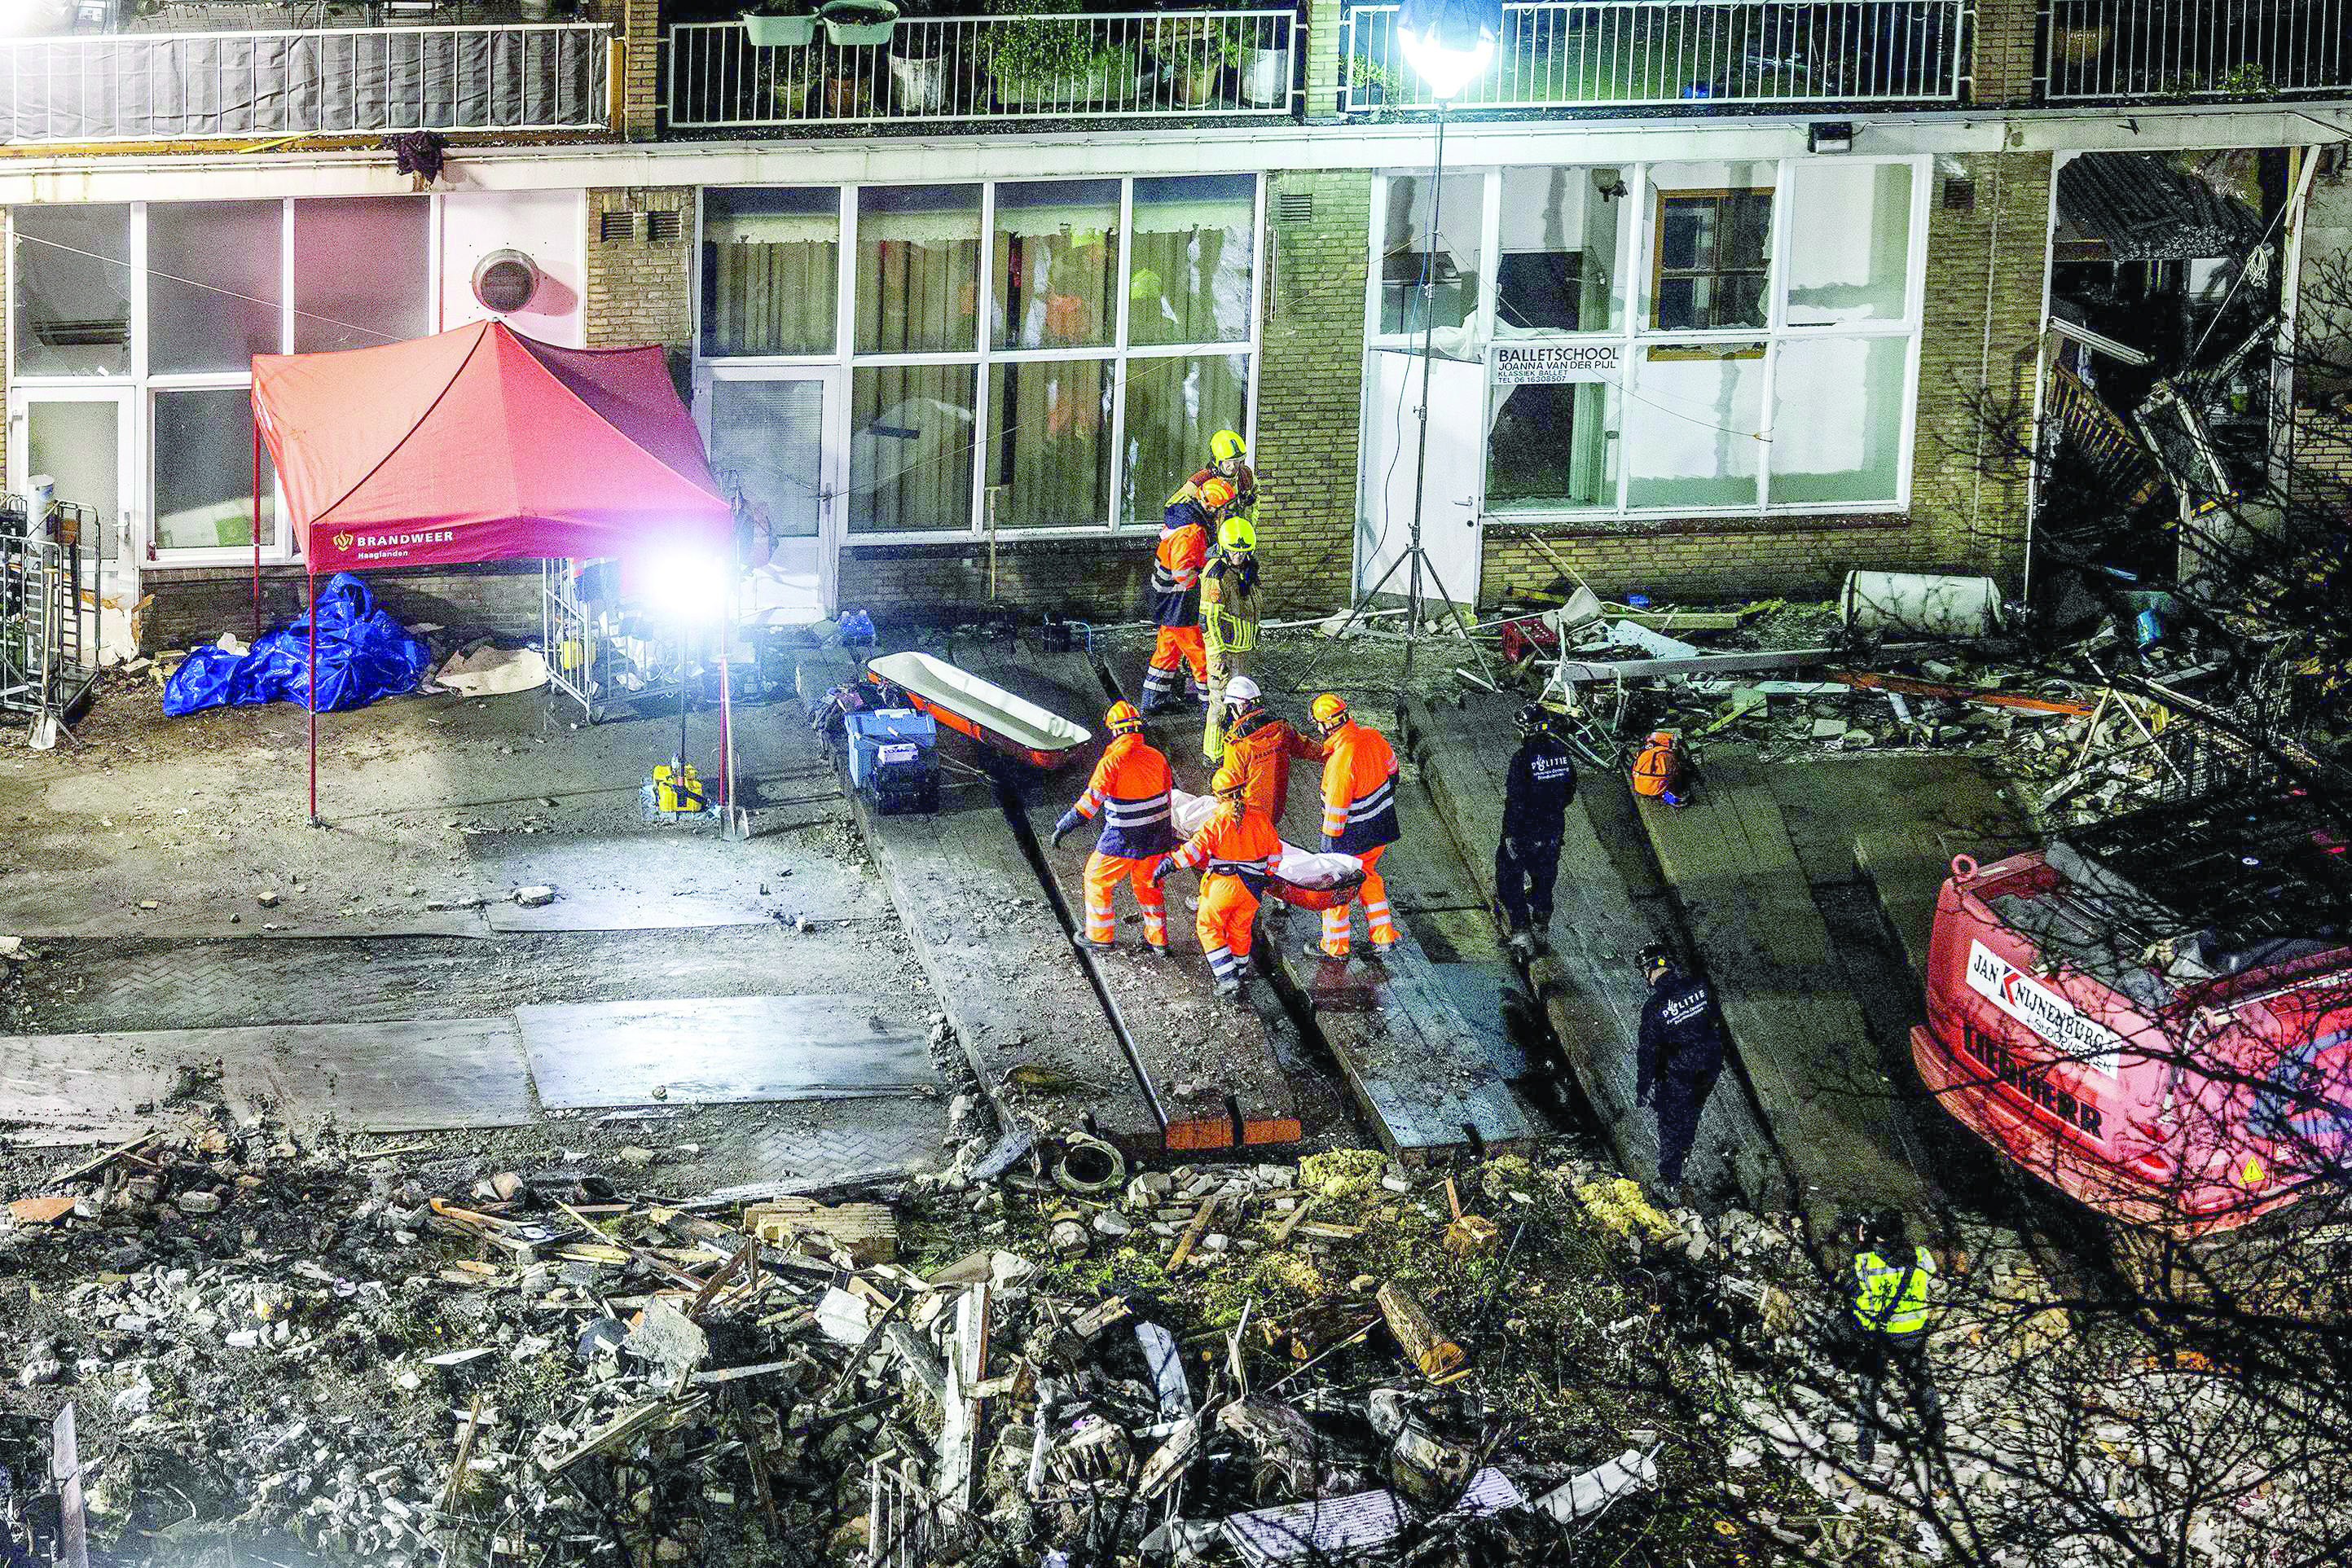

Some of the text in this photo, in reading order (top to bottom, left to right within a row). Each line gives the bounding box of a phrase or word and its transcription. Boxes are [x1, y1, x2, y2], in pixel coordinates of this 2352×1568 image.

[1499, 347, 1619, 362] BALLETSCHOOL
[1498, 360, 1616, 371] JOANNA VAN DER PIJL
[357, 531, 454, 547] BRANDWEER
[358, 550, 409, 560] Haaglanden
[1973, 955, 1999, 985] JAN
